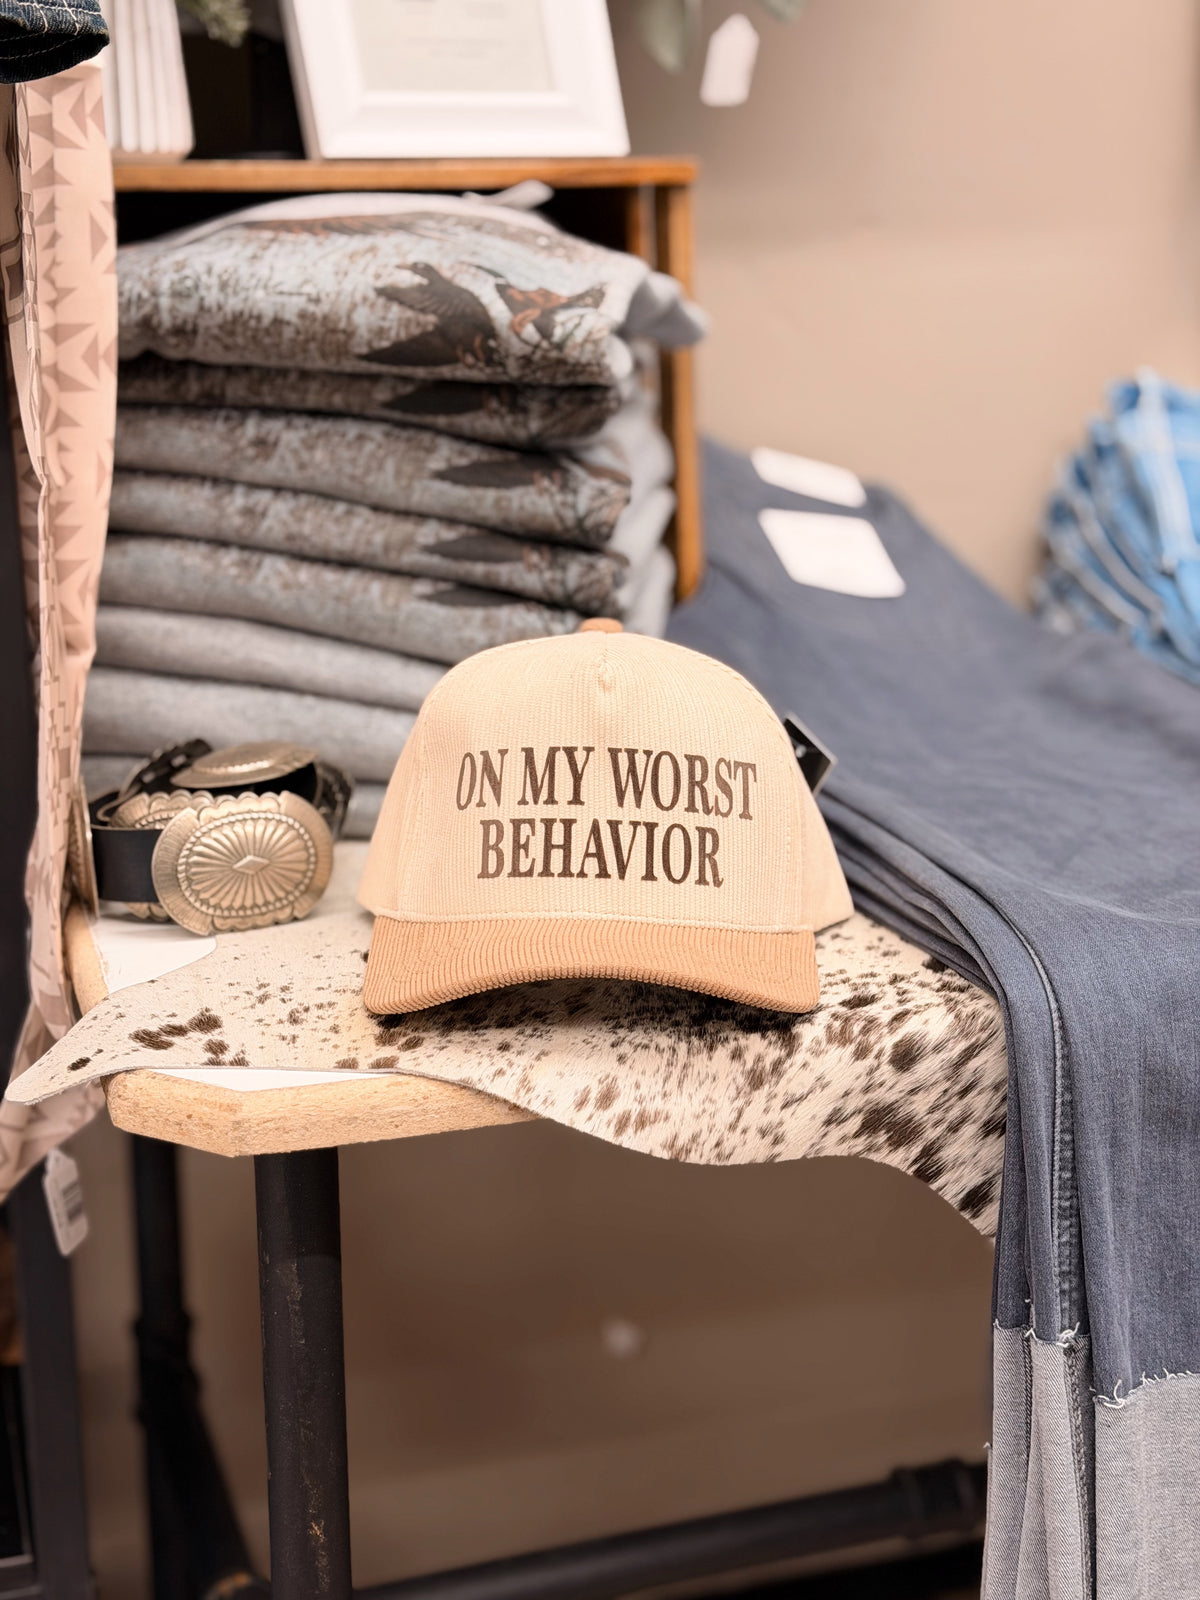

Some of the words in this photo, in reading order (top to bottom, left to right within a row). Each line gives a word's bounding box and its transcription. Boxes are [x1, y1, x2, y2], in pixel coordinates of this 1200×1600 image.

[456, 748, 509, 811] ON
[517, 746, 595, 806] MY
[607, 747, 757, 820] WORST
[477, 818, 724, 888] BEHAVIOR
